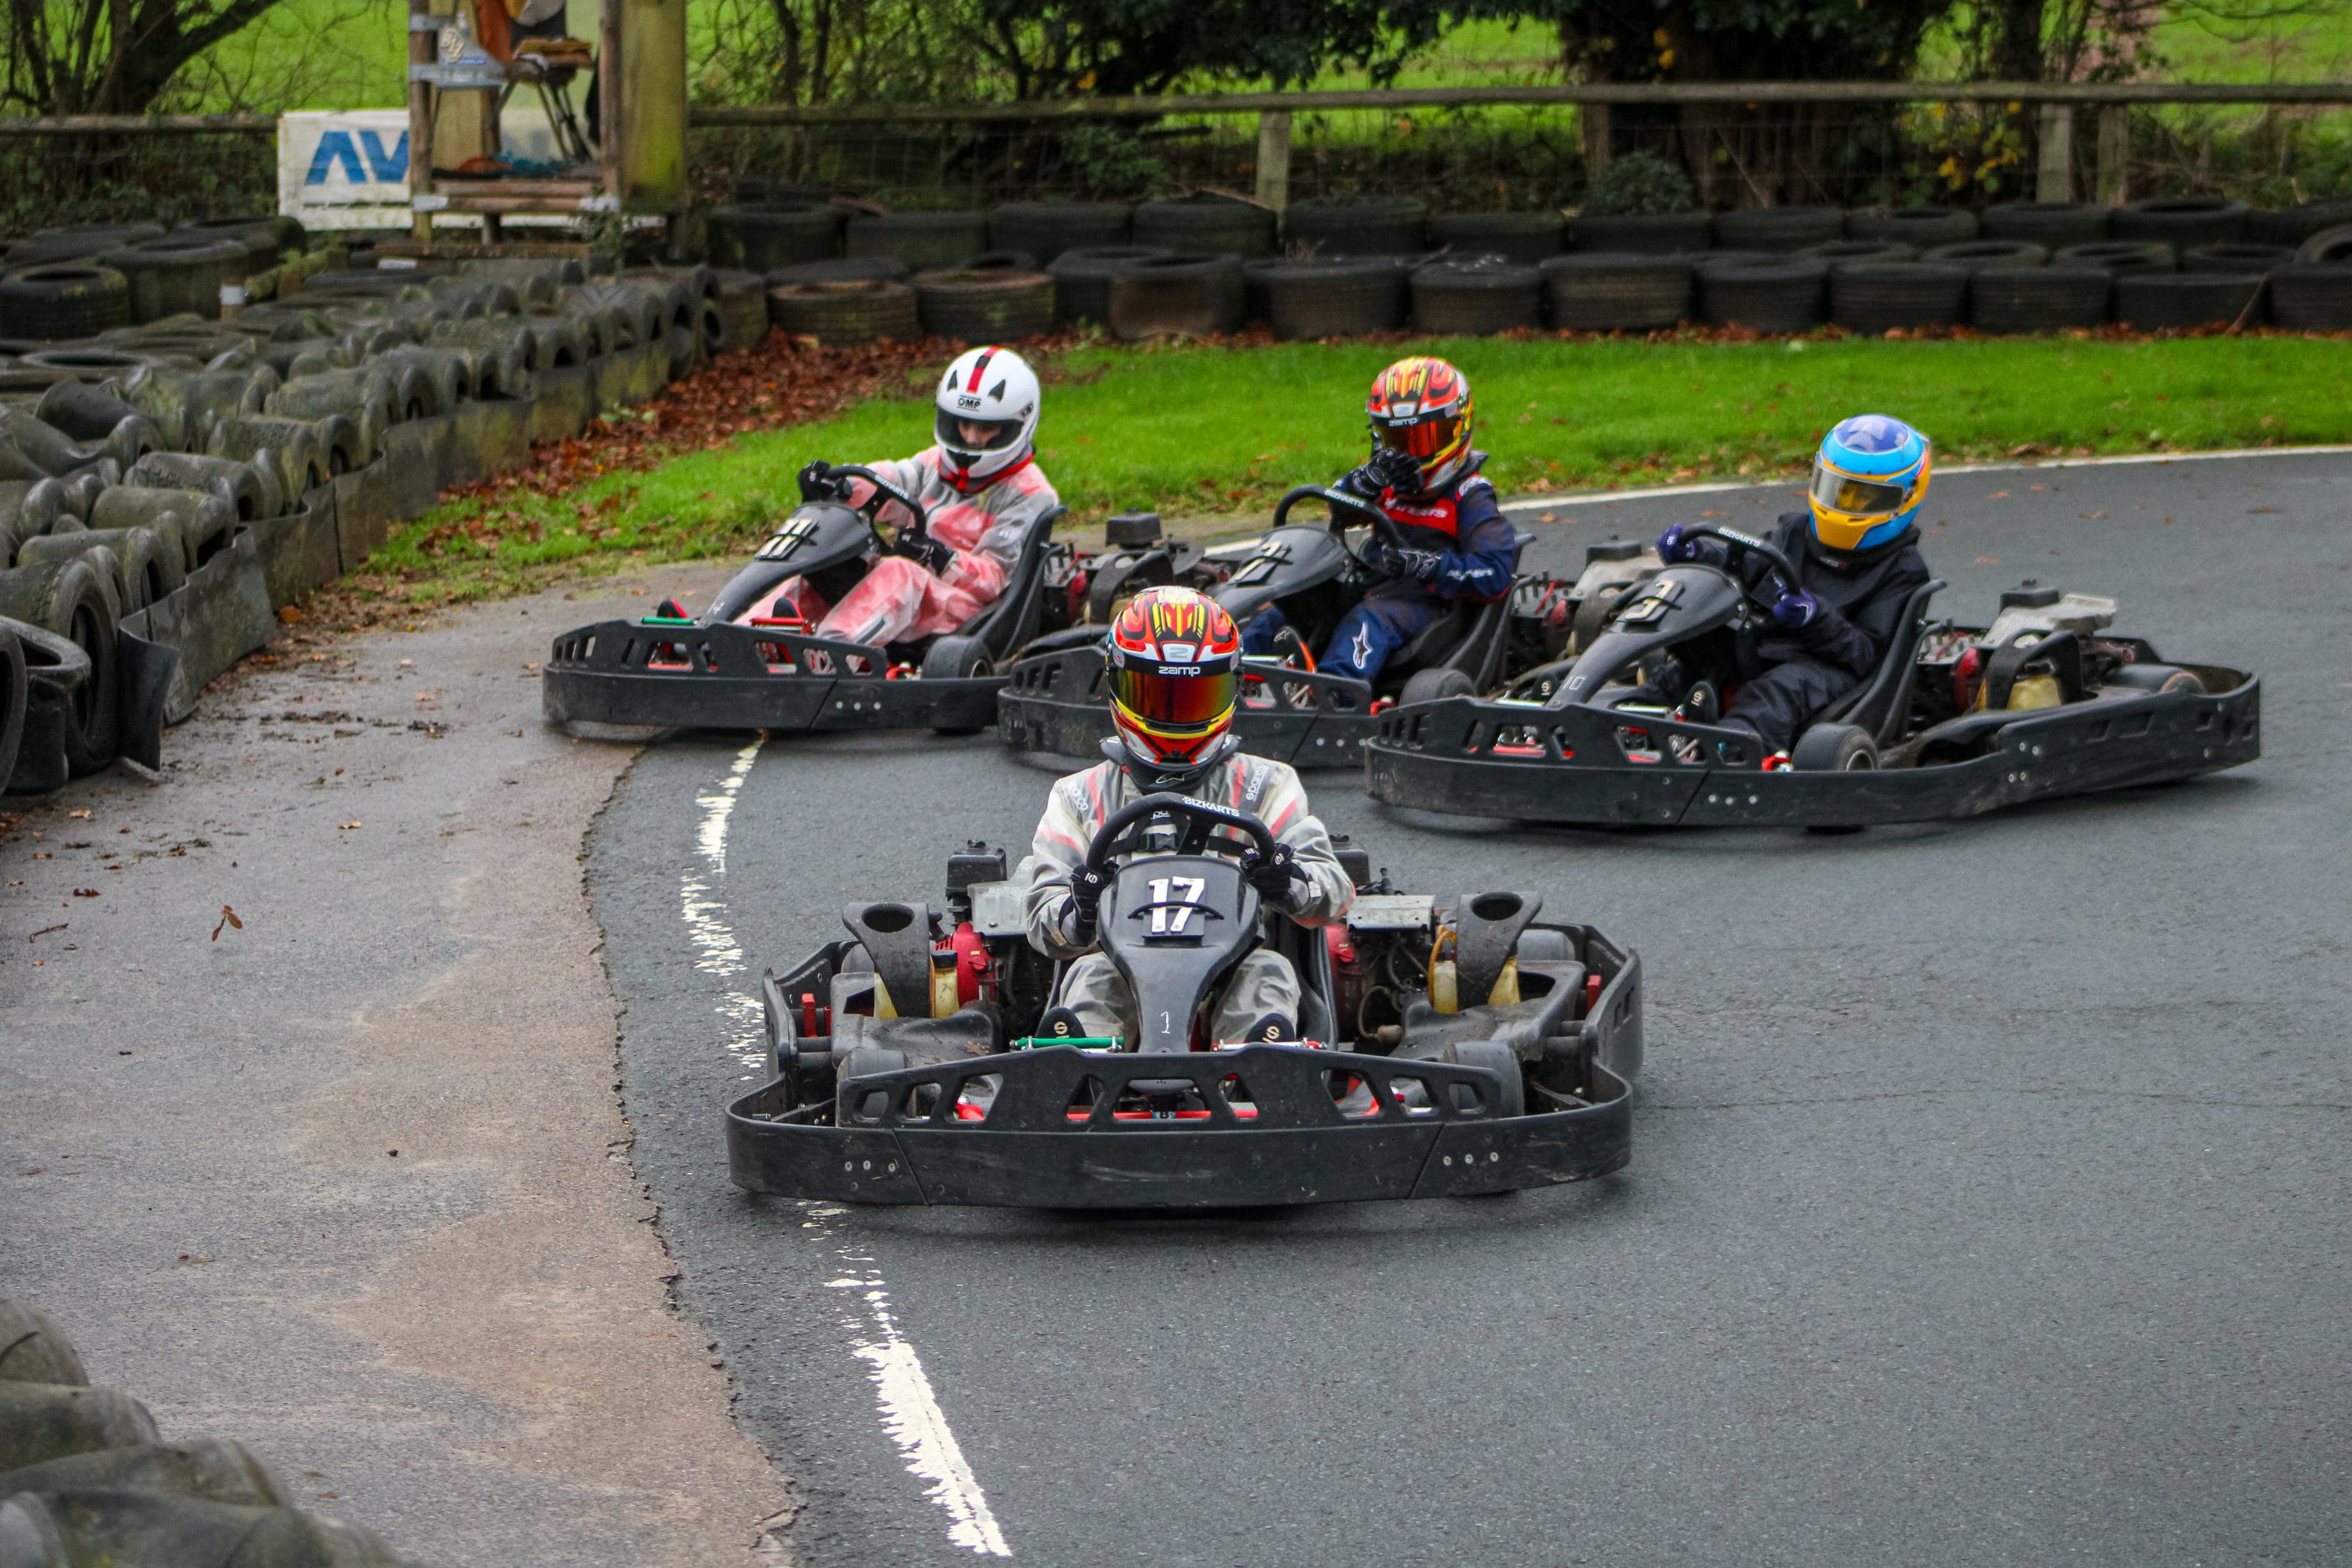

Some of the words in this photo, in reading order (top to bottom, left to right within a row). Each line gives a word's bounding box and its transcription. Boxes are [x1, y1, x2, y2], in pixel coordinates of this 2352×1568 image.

[957, 398, 981, 409] OMP
[1158, 666, 1201, 677] zamp
[1183, 795, 1240, 817] BIZKARTS
[1148, 875, 1205, 933] 17
[1160, 1011, 1171, 1034] 1
